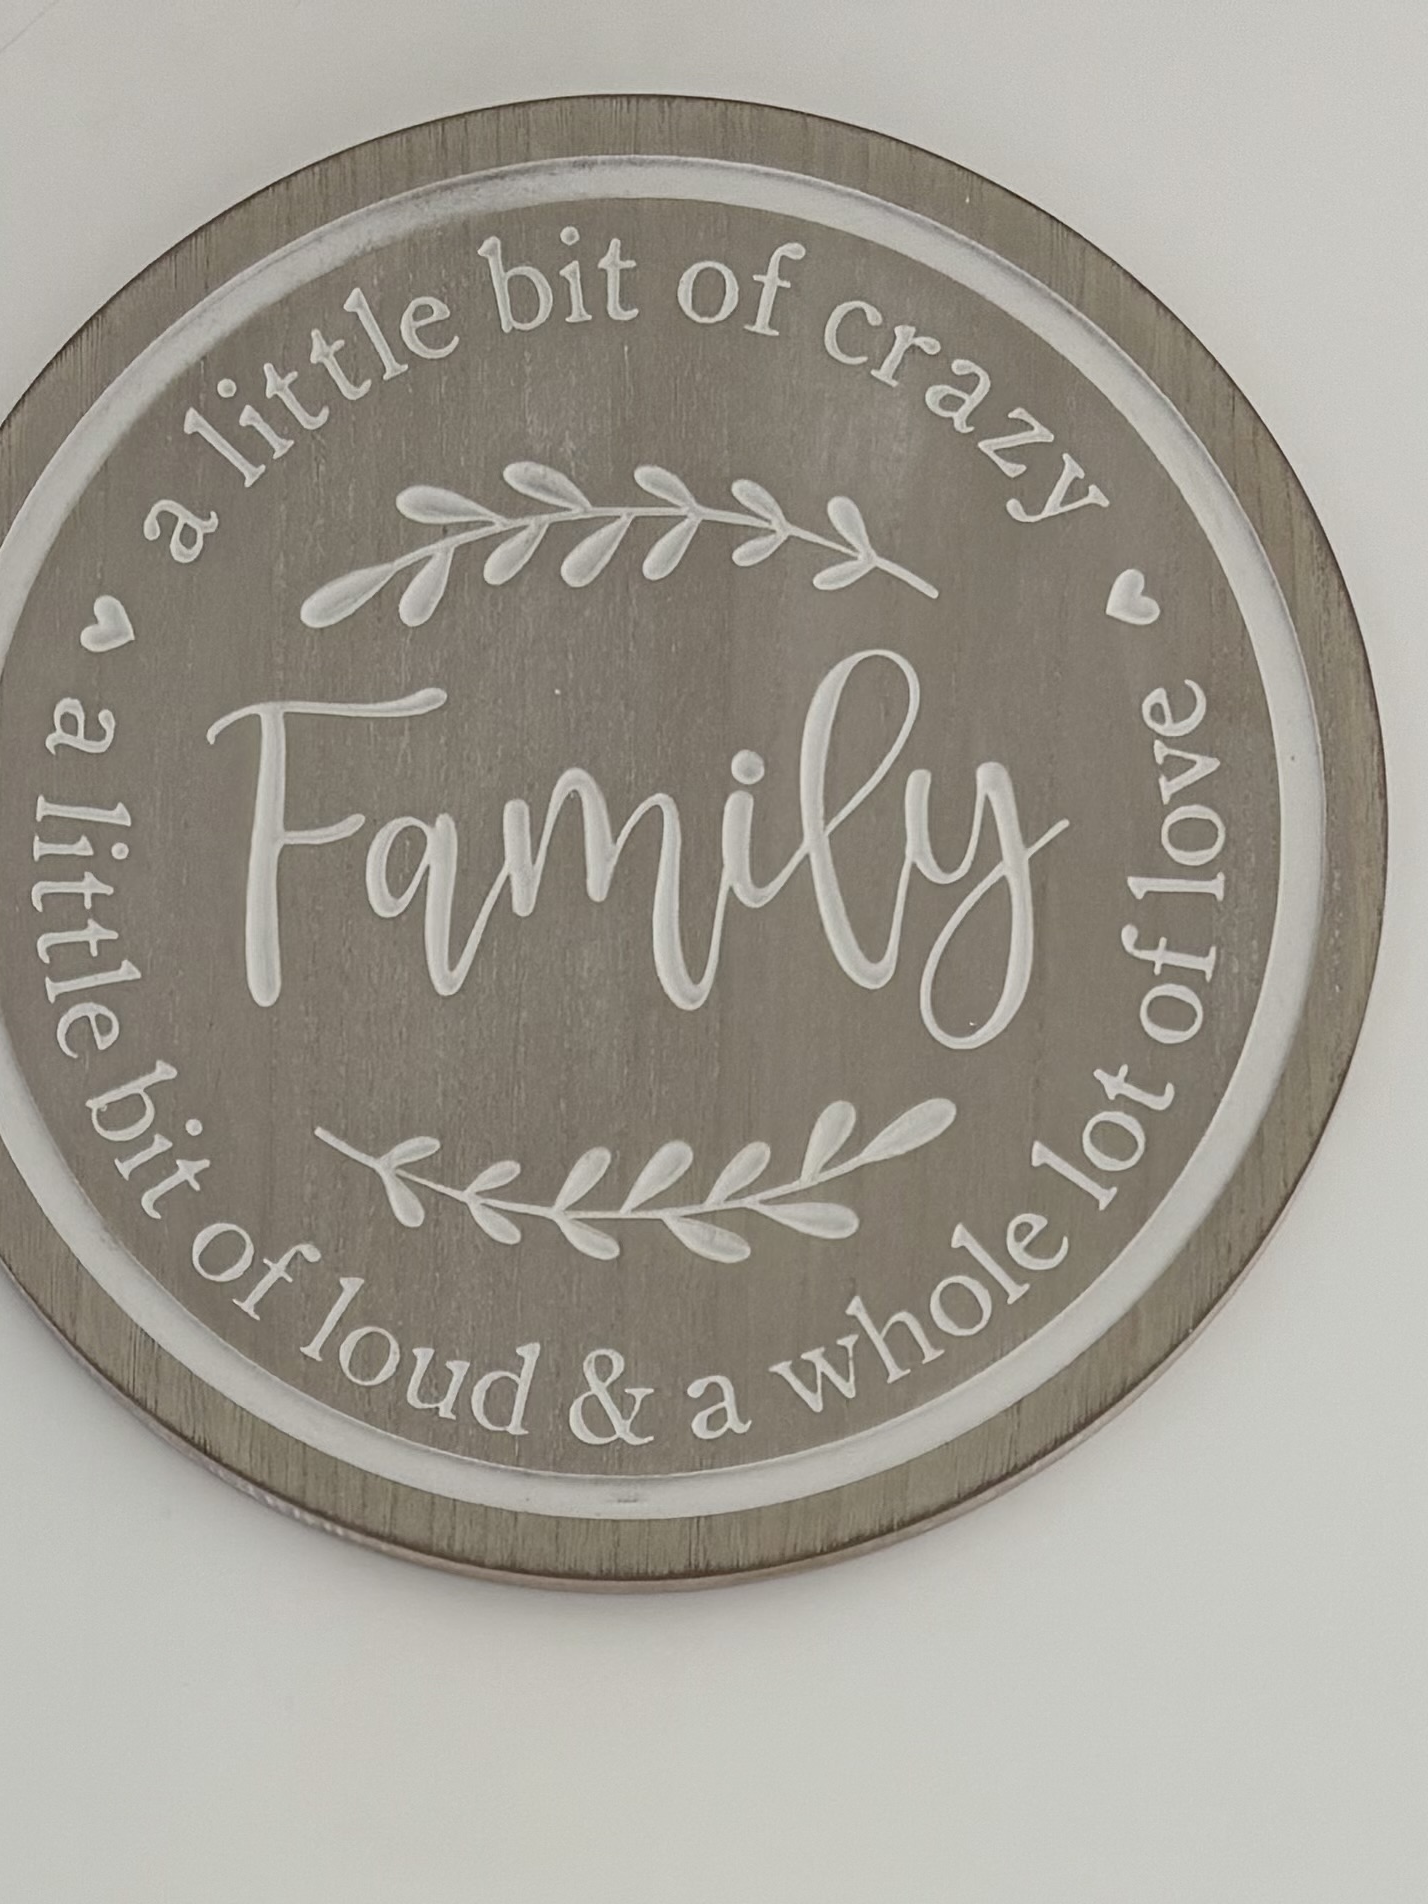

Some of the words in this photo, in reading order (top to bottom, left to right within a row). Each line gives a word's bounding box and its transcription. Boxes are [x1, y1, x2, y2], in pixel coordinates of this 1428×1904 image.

[142, 498, 220, 565] a
[182, 286, 461, 489] little
[476, 225, 640, 334] bit
[676, 241, 807, 337] of
[823, 299, 1111, 524] crazy
[44, 696, 117, 756] a
[1125, 678, 1227, 902] love
[30, 793, 143, 1060] little
[205, 647, 1071, 1051] Family
[1119, 923, 1218, 1045] of
[84, 1058, 212, 1220] bit
[1030, 1062, 1176, 1212] lot
[191, 1221, 323, 1322] of
[767, 1211, 1070, 1414] whole
[298, 1275, 542, 1437] loud
[568, 1347, 656, 1447] &
[685, 1373, 754, 1441] a
